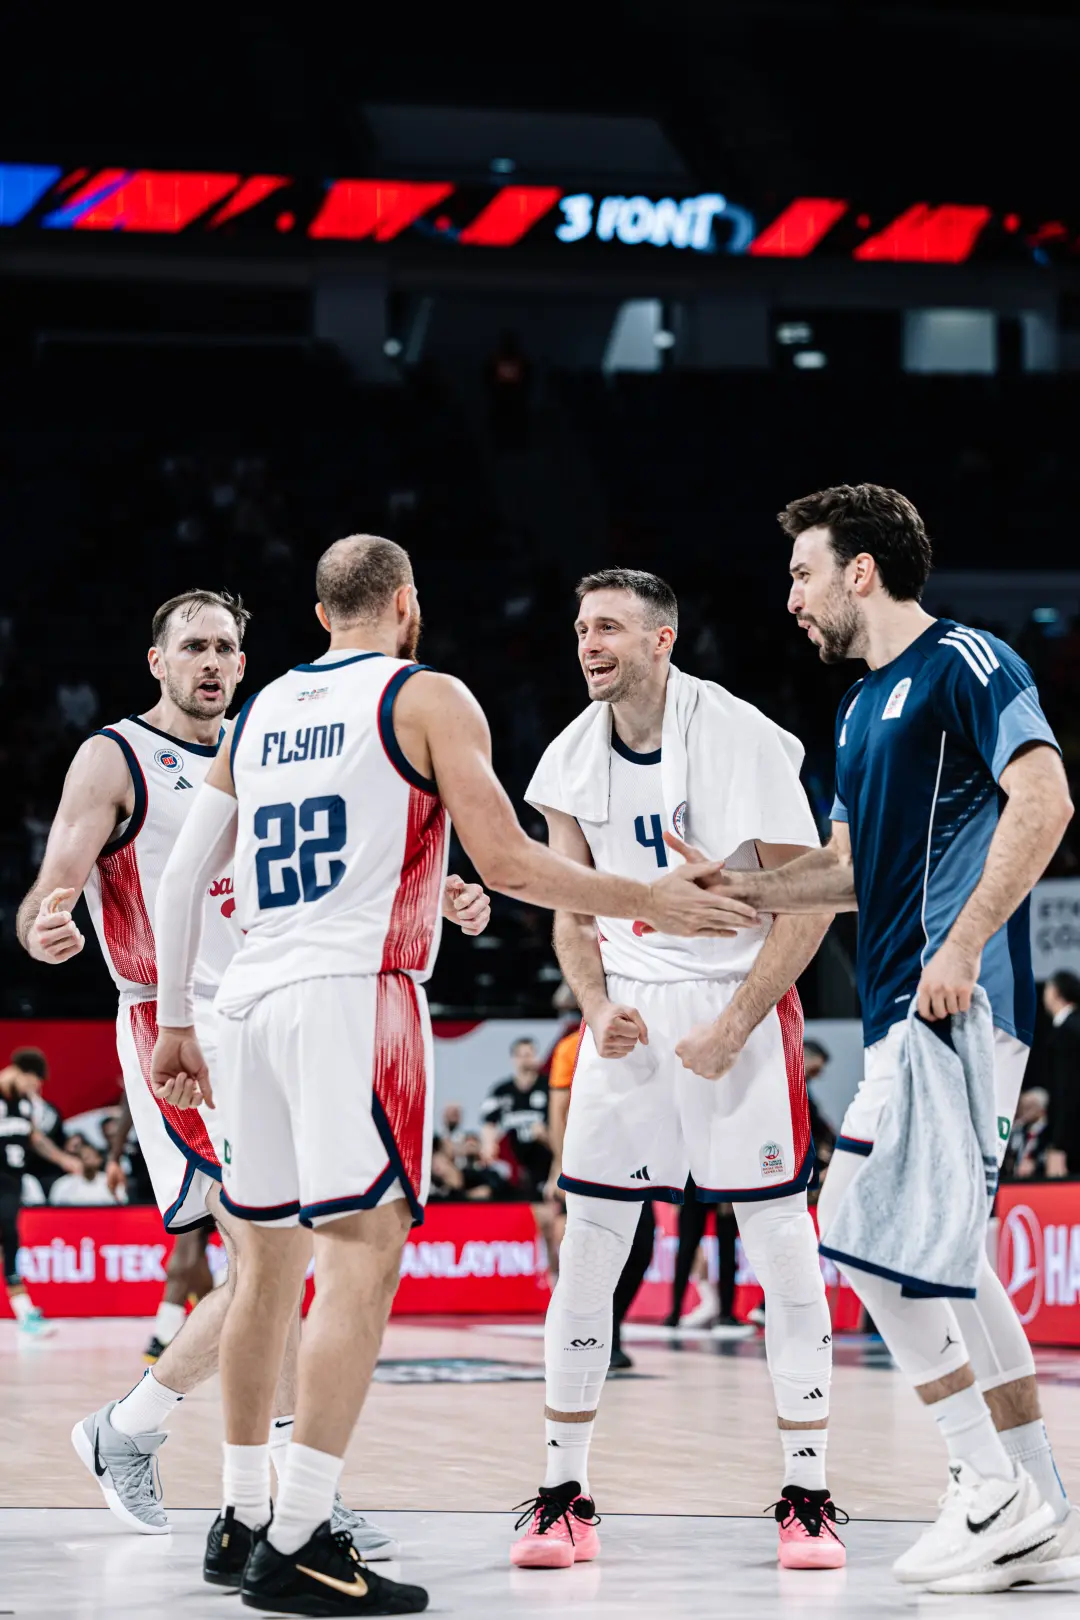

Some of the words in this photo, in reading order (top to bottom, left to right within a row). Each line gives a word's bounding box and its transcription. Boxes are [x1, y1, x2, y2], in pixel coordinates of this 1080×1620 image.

[557, 194, 592, 243] 3
[262, 722, 345, 767] FLYNN
[254, 794, 347, 911] 22
[634, 813, 668, 868] 4
[99, 1244, 167, 1283] TEK
